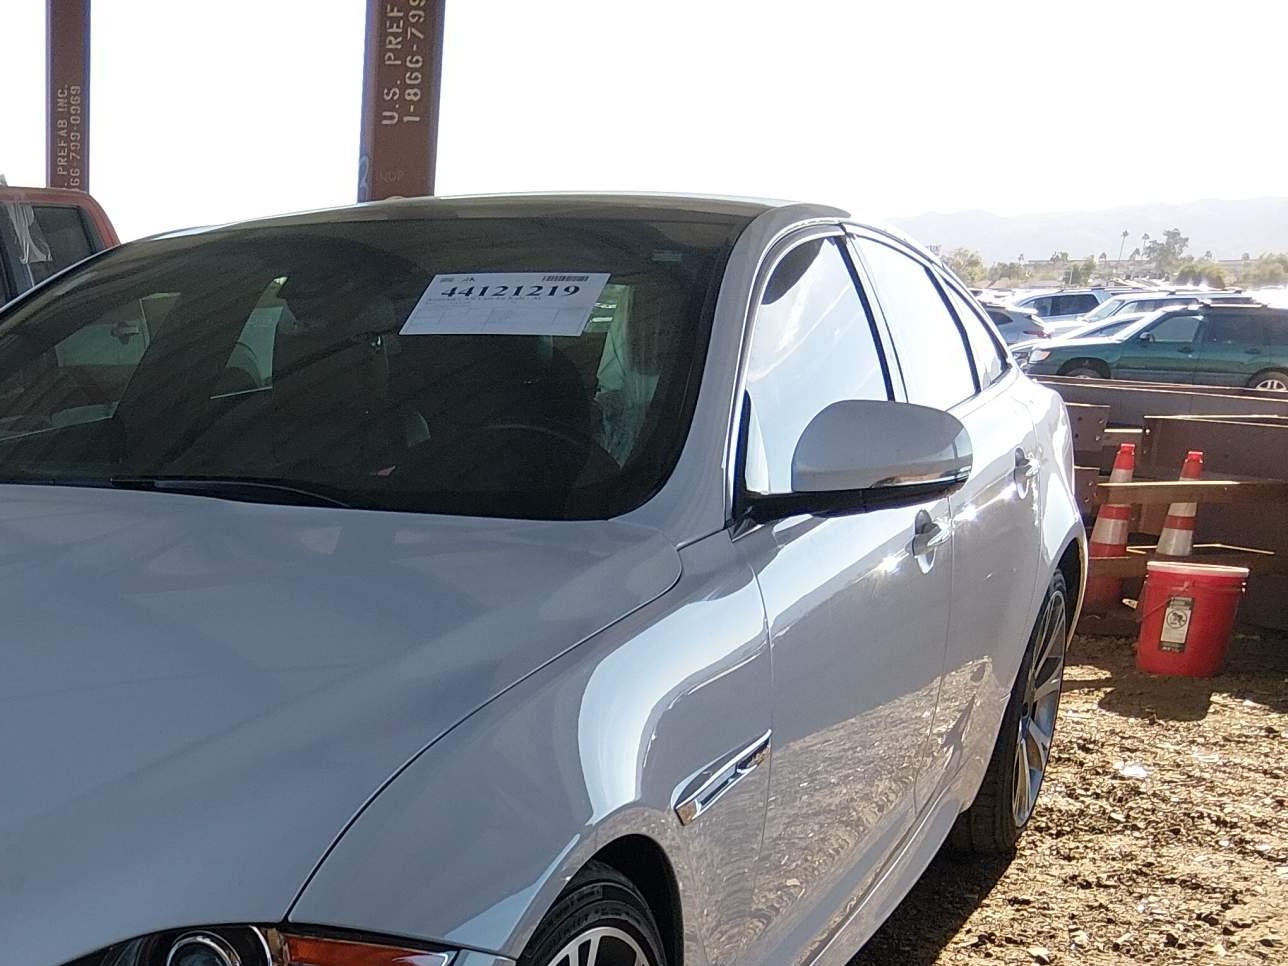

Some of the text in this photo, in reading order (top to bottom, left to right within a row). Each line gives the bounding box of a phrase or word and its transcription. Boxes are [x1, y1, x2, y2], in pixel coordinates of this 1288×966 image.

[381, 4, 404, 125] U.S. PREF
[57, 84, 69, 175] PREFAB INC.
[69, 85, 81, 192] 66-799-0969
[440, 285, 581, 298] 44121219
